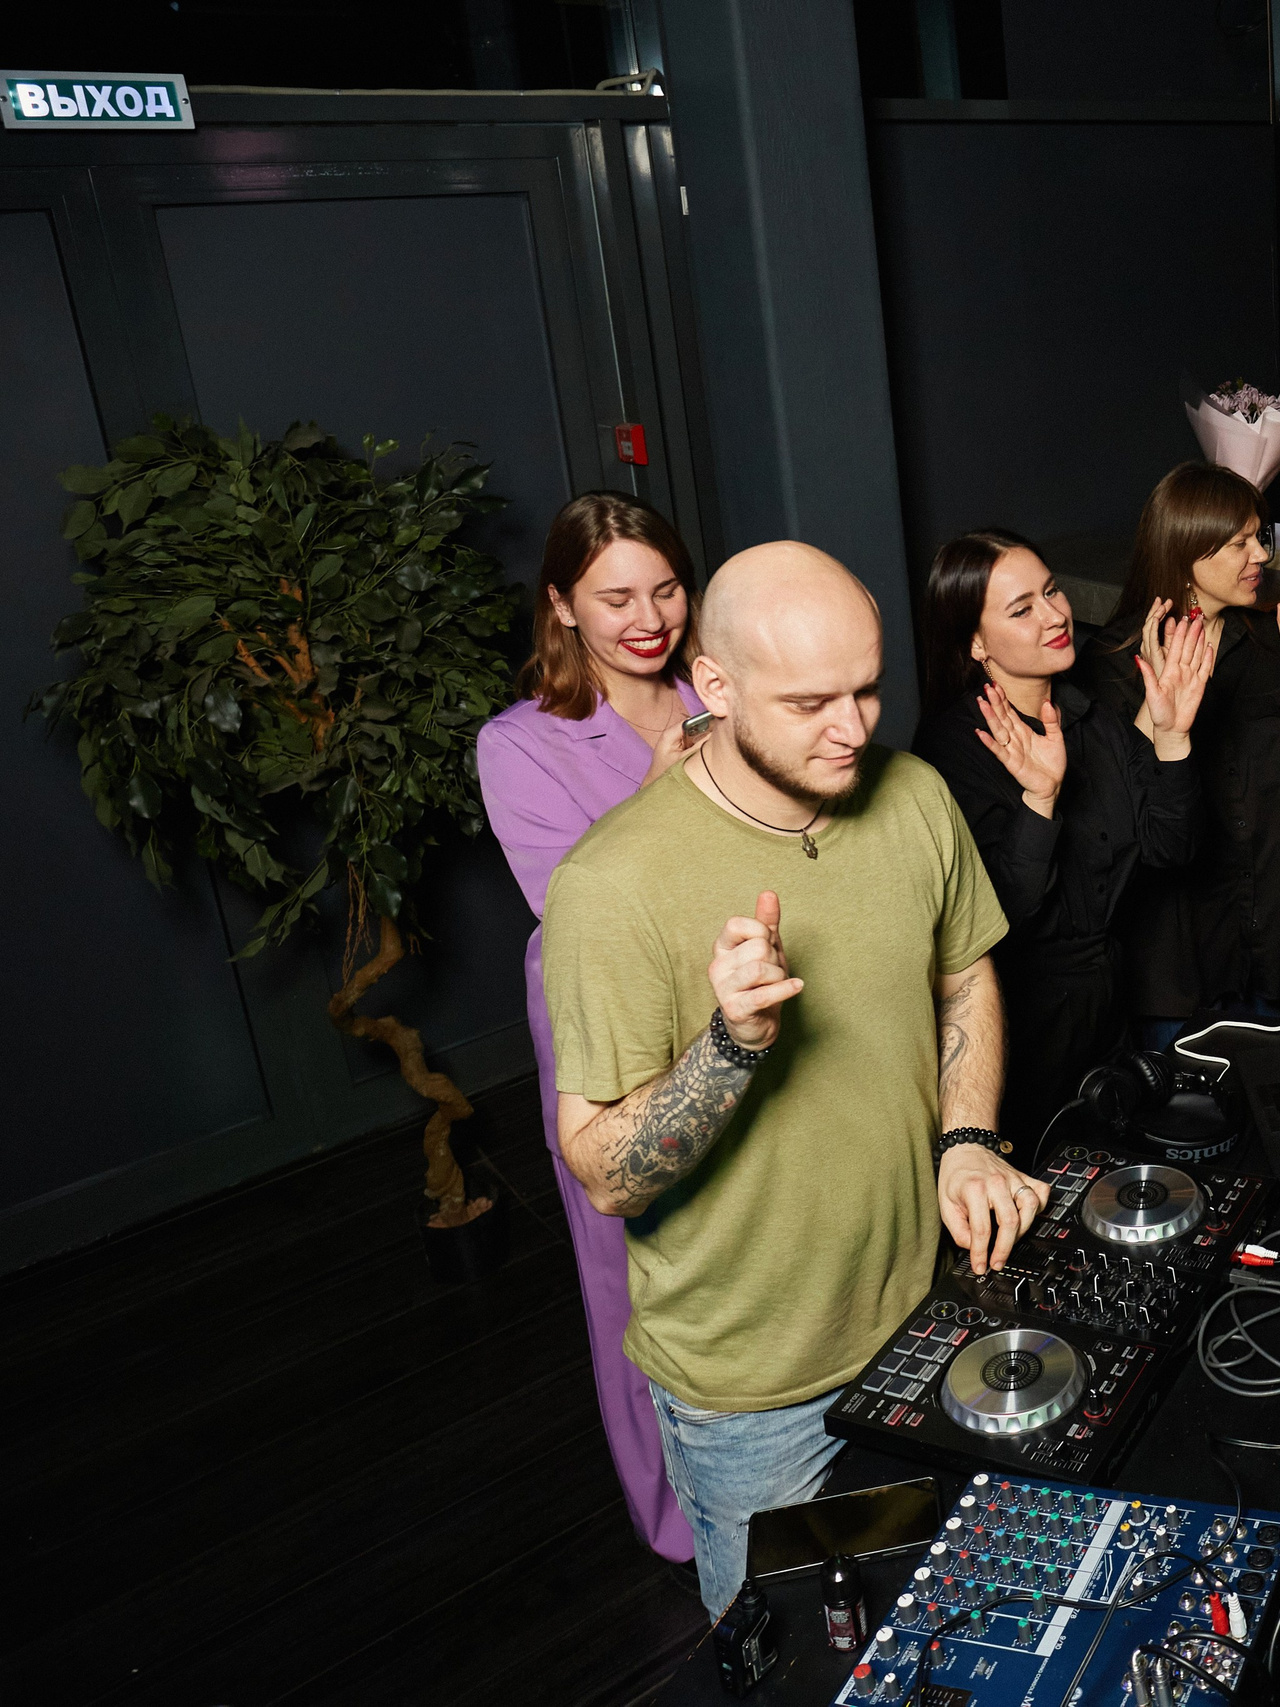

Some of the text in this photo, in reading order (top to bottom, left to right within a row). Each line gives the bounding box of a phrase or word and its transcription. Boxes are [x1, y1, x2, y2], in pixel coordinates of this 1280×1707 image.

[15, 82, 175, 119] ВЫХОД
[1161, 1565, 1171, 1576] 3/4
[1069, 1608, 1080, 1619] 7/8
[1053, 1635, 1066, 1650] 9/10
[841, 1676, 856, 1695] TEREO
[1027, 1673, 1041, 1695] CONSOLE
